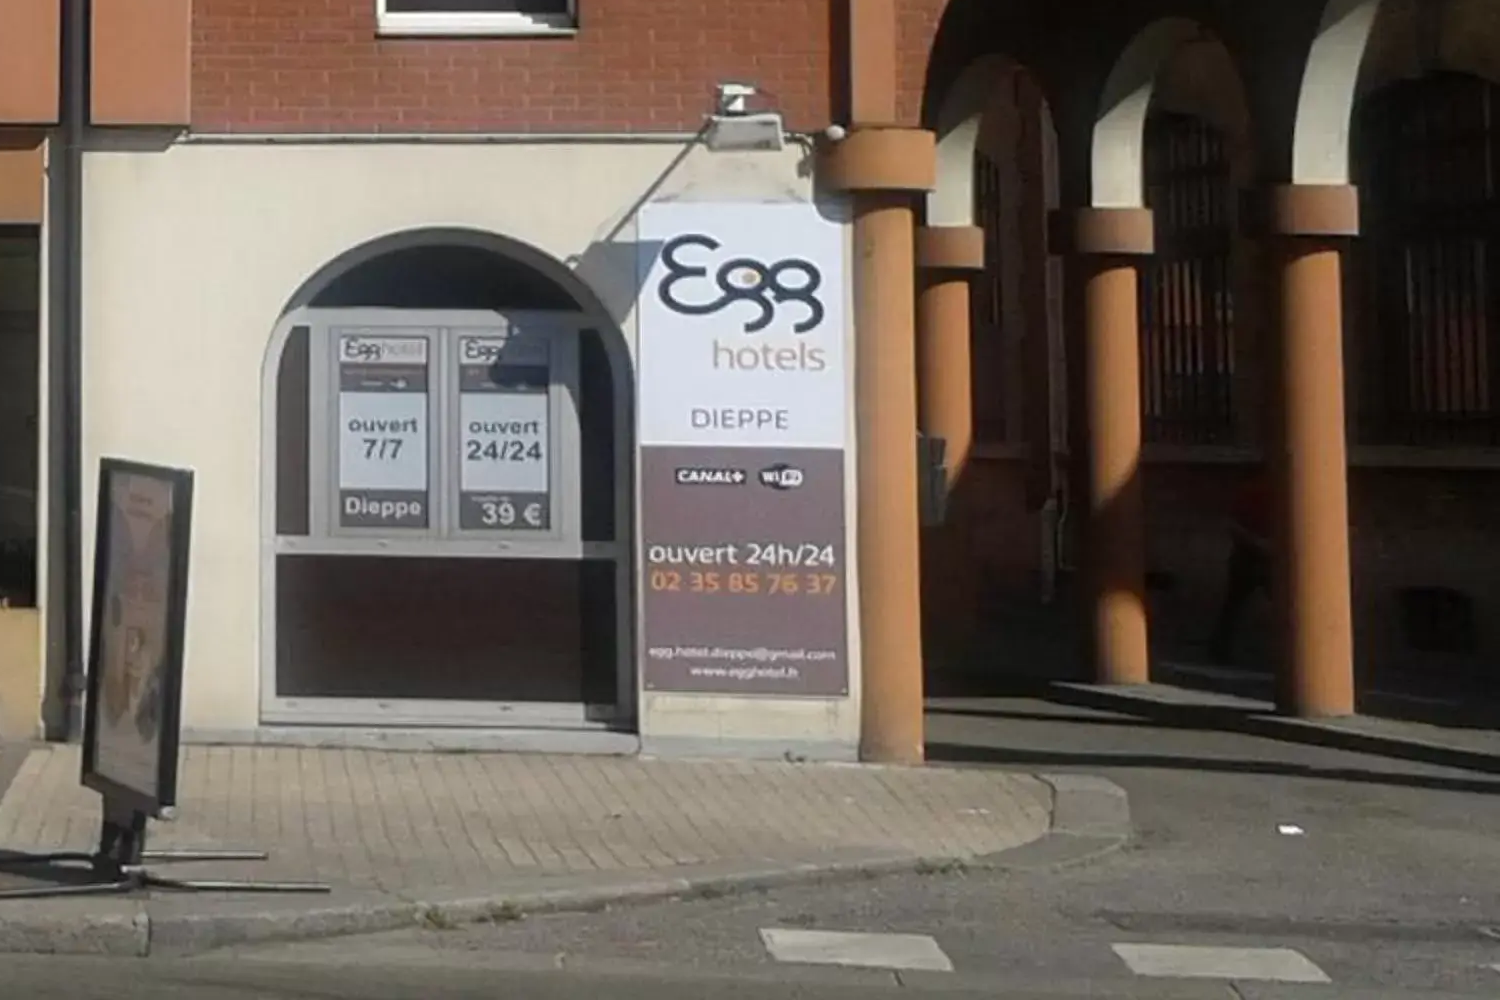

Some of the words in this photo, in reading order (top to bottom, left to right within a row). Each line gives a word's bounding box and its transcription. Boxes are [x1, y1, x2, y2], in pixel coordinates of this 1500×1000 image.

[658, 233, 824, 334] Egg
[713, 339, 826, 371] hotels
[348, 418, 418, 433] ouvert
[468, 420, 539, 435] ouvert
[691, 408, 790, 429] DIEPPE
[363, 438, 403, 460] 7/7
[467, 441, 542, 461] 24/24
[345, 497, 422, 519] Dieppe
[481, 502, 516, 526] 39
[523, 502, 542, 527] €
[649, 545, 737, 564] ouvert
[746, 543, 835, 565] 24h/24
[652, 571, 680, 591] 02
[690, 571, 720, 592] 35
[728, 572, 759, 593] 85
[767, 573, 799, 594] 76
[806, 573, 837, 594] 37
